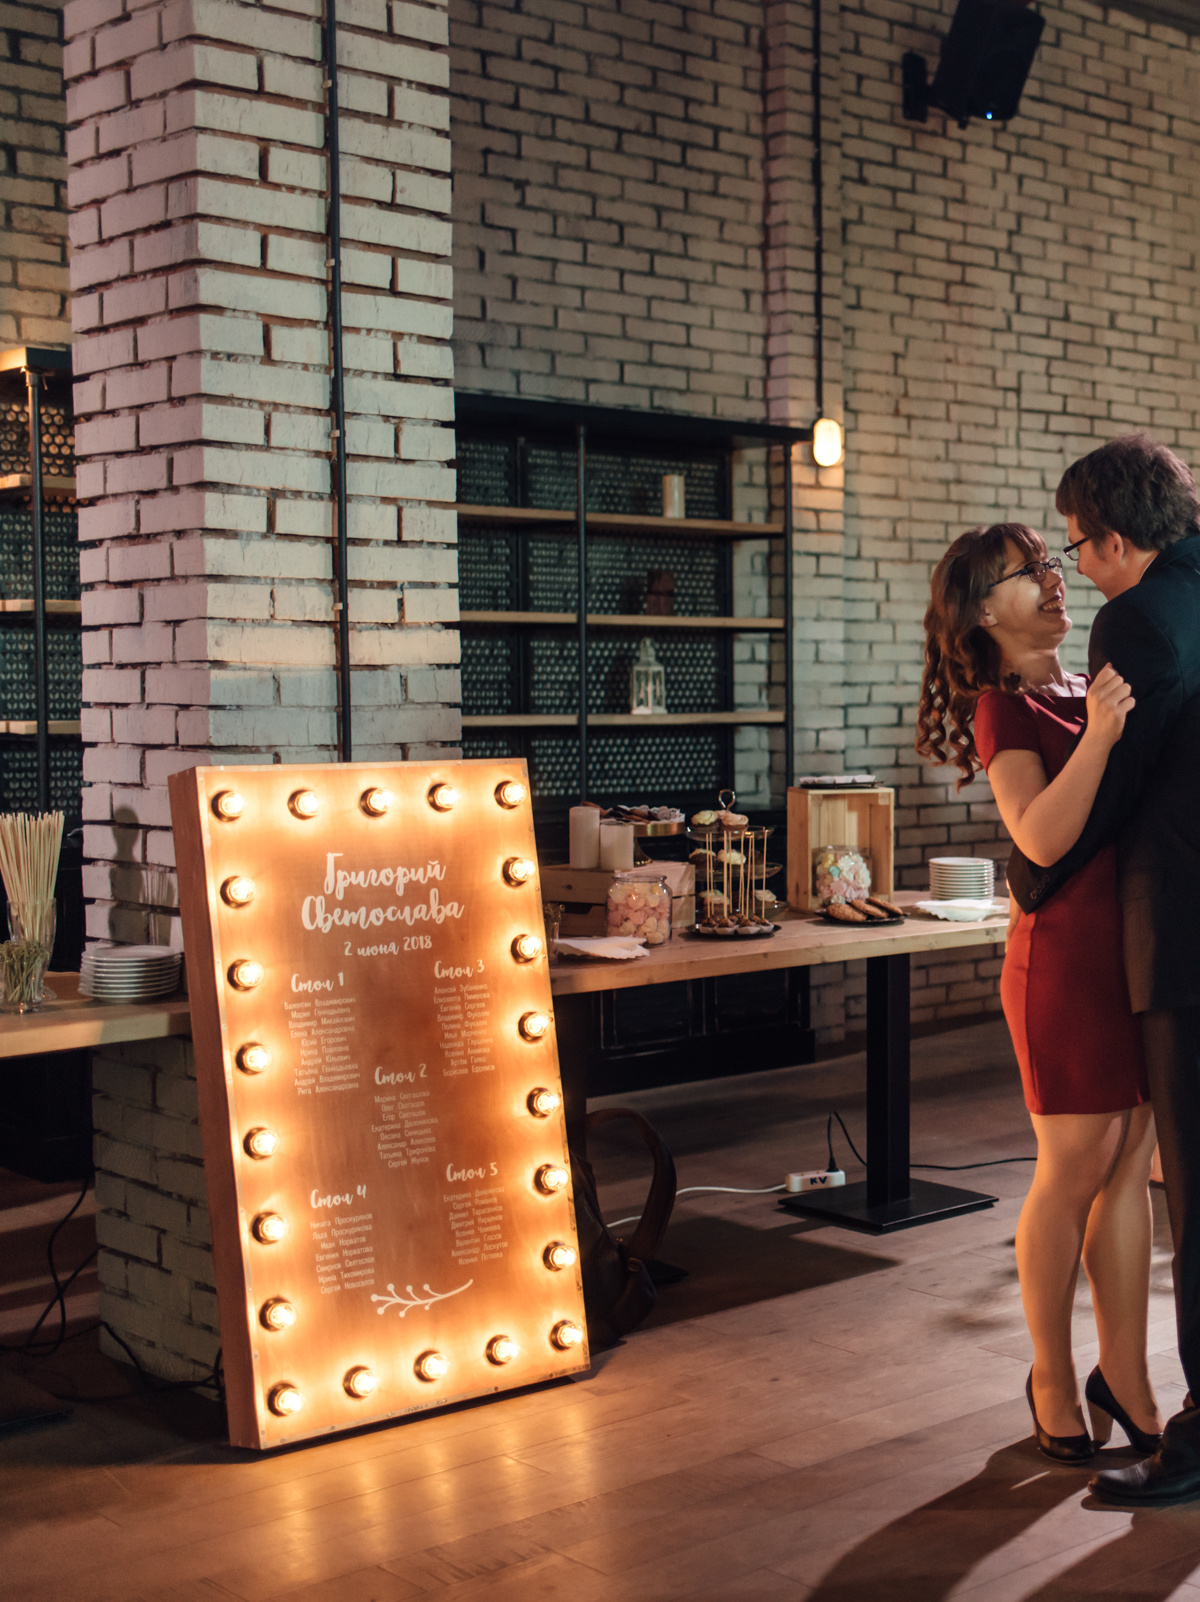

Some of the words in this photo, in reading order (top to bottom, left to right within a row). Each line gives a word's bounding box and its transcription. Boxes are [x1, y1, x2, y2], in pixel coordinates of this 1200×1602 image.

[324, 852, 446, 900] Григорий
[302, 888, 464, 933] Светослава
[344, 942, 352, 955] 2
[358, 942, 399, 956] июня
[403, 936, 432, 950] 2018
[434, 960, 473, 979] Стол
[477, 959, 484, 973] 3
[291, 974, 334, 993] Стол
[338, 972, 344, 986] 1
[315, 998, 355, 1006] Владимирович
[315, 1008, 350, 1016] Геннадьевна
[321, 1017, 355, 1025] Михайлович
[291, 1030, 307, 1038] Елена
[312, 1026, 355, 1035] Александровна
[302, 1057, 322, 1065] Андрей
[295, 1068, 318, 1076] Татьяна
[322, 1064, 358, 1072] Геннадьевна
[375, 1066, 415, 1085] Стол
[419, 1064, 427, 1077] 2
[295, 1078, 315, 1086] Андрей
[320, 1073, 360, 1083] Владимирович
[316, 1082, 359, 1093] Александровна
[372, 1123, 401, 1133] Екатерина
[380, 1151, 402, 1159] Татьяна
[446, 1163, 486, 1182] Стол
[490, 1162, 498, 1176] 5
[310, 1189, 353, 1208] Стол
[357, 1184, 366, 1198] 4
[321, 1242, 335, 1250] Иван
